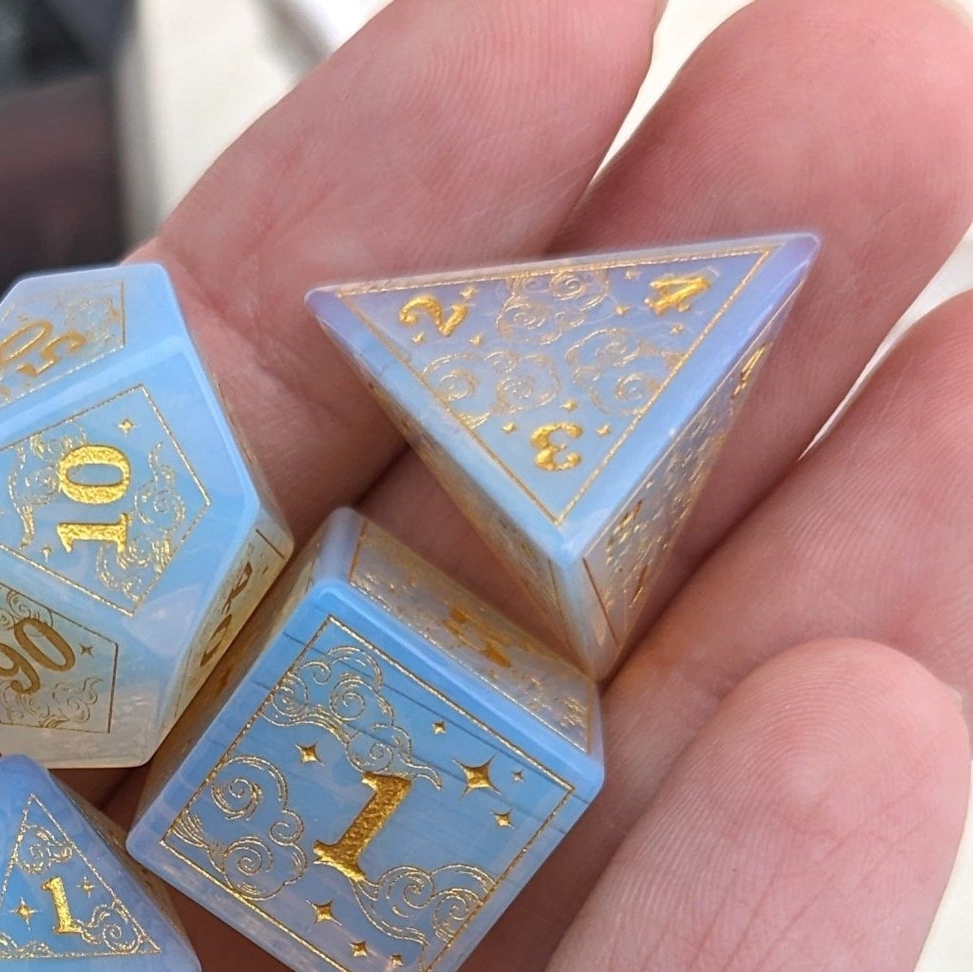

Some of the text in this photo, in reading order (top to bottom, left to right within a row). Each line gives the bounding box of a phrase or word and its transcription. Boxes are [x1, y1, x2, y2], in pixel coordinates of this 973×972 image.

[398, 295, 469, 337] 2
[645, 275, 712, 315] 4
[530, 422, 584, 472] 3
[56, 444, 131, 555] 10
[313, 770, 413, 883] 1
[41, 876, 80, 935] 1
